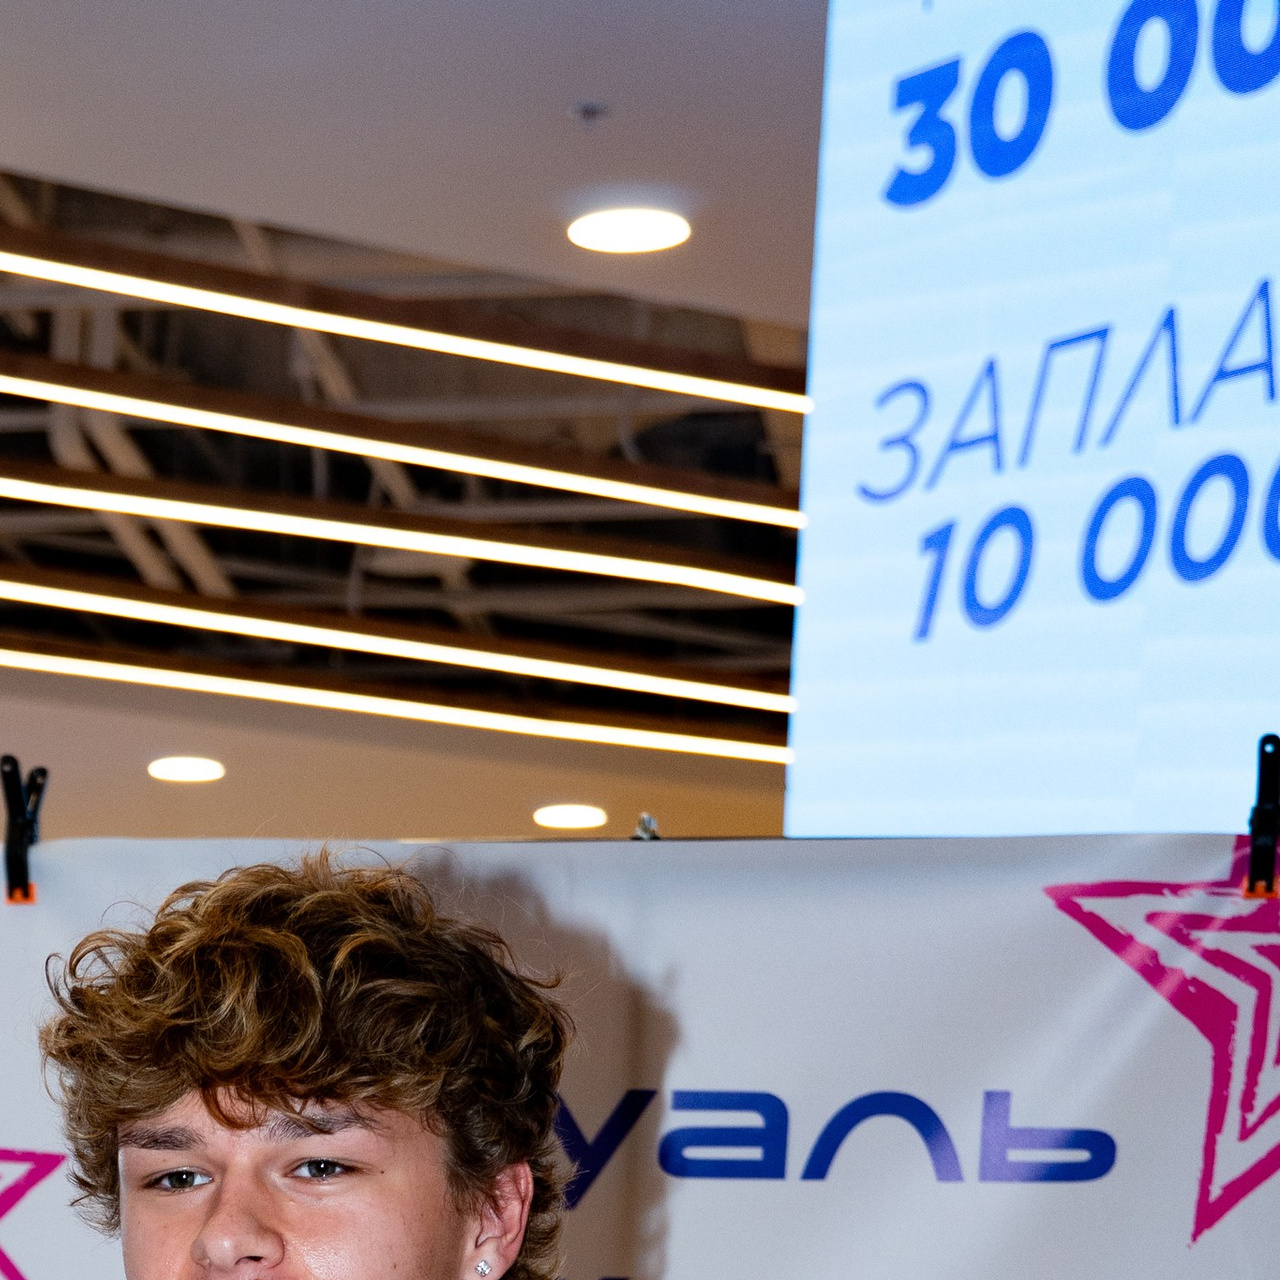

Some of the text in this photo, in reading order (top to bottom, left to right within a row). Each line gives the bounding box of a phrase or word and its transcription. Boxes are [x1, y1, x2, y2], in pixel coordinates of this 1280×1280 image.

[882, 30, 1054, 209] 30
[857, 277, 1278, 503] ЗАПЛА
[913, 452, 1280, 643] 10 00
